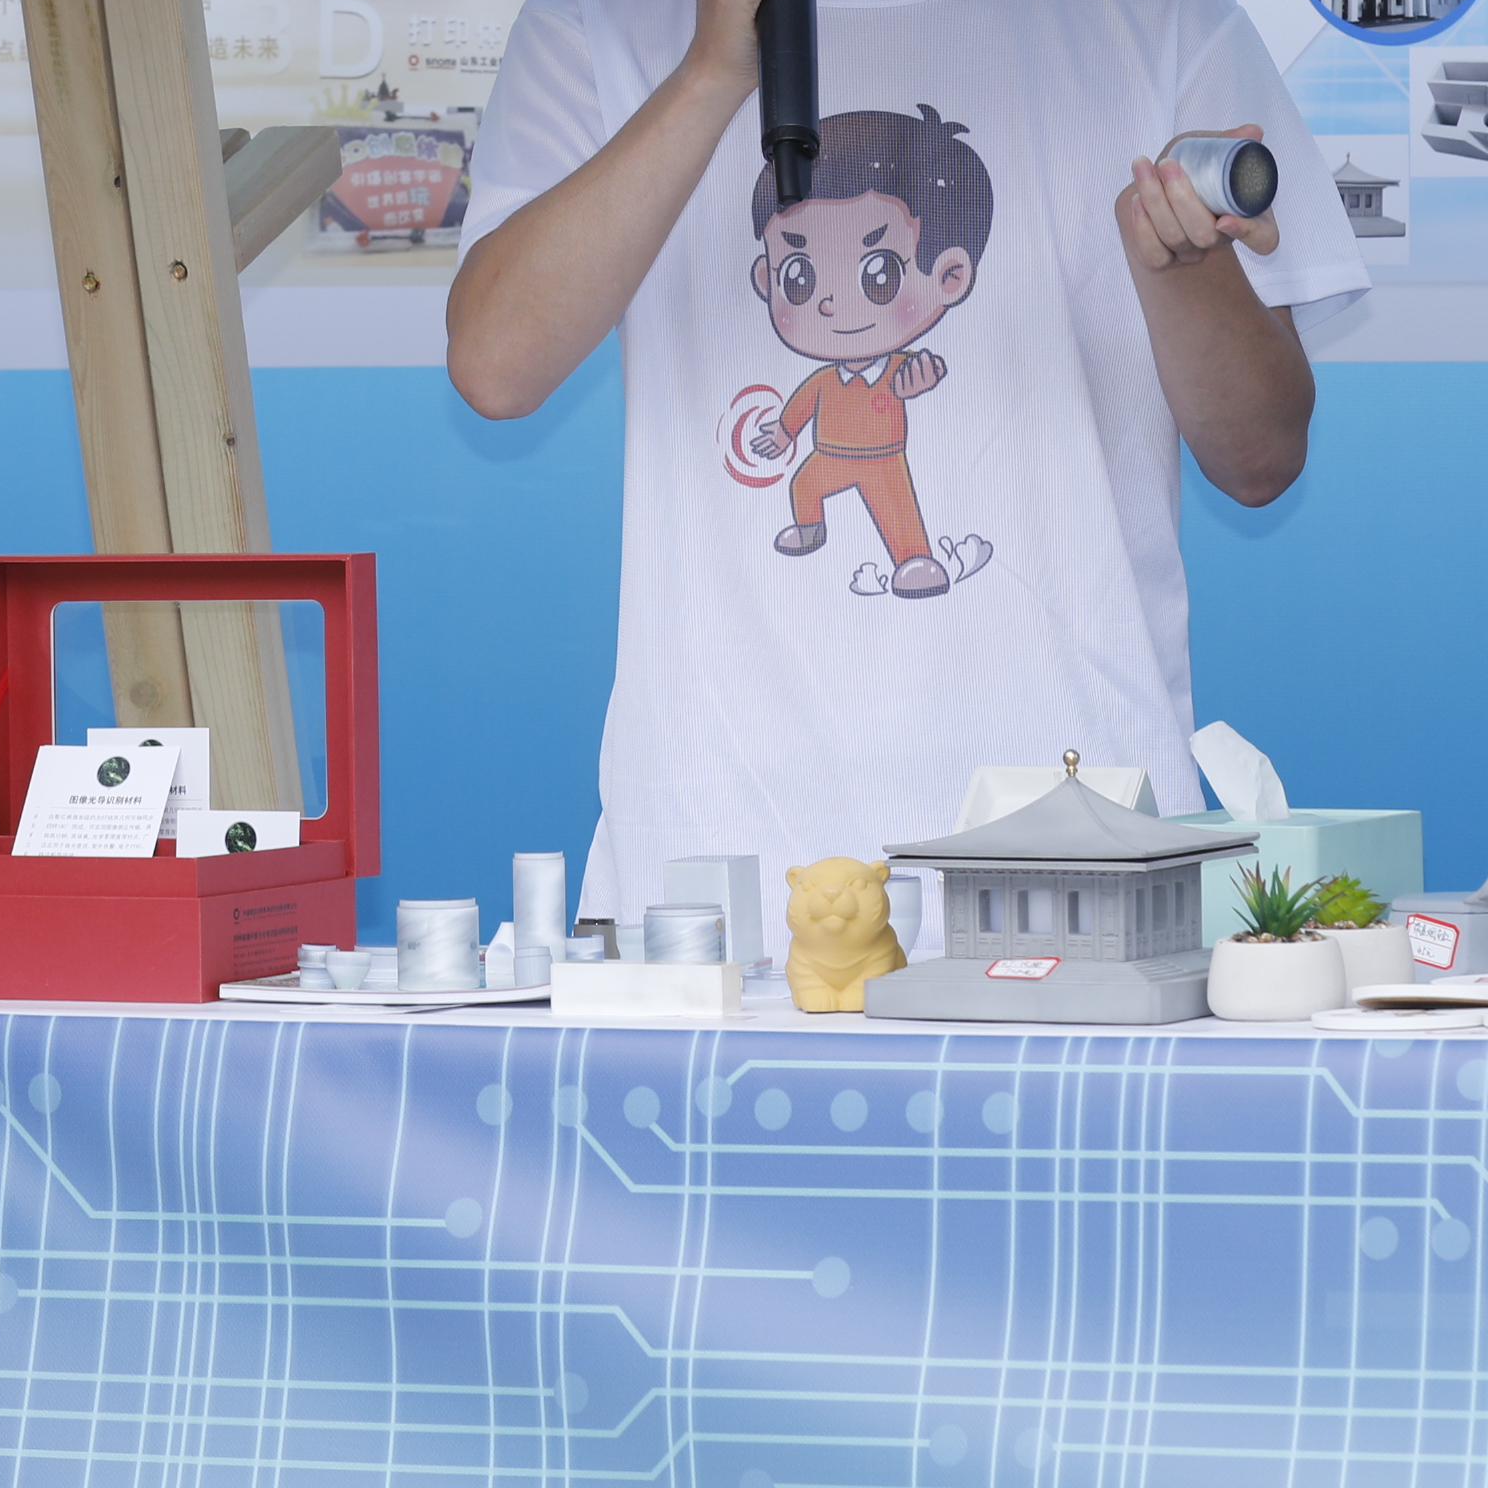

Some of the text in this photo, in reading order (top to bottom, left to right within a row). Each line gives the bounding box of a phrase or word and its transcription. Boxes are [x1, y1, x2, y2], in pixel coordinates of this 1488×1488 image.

[69, 795, 142, 805] 图像光导识别材料
